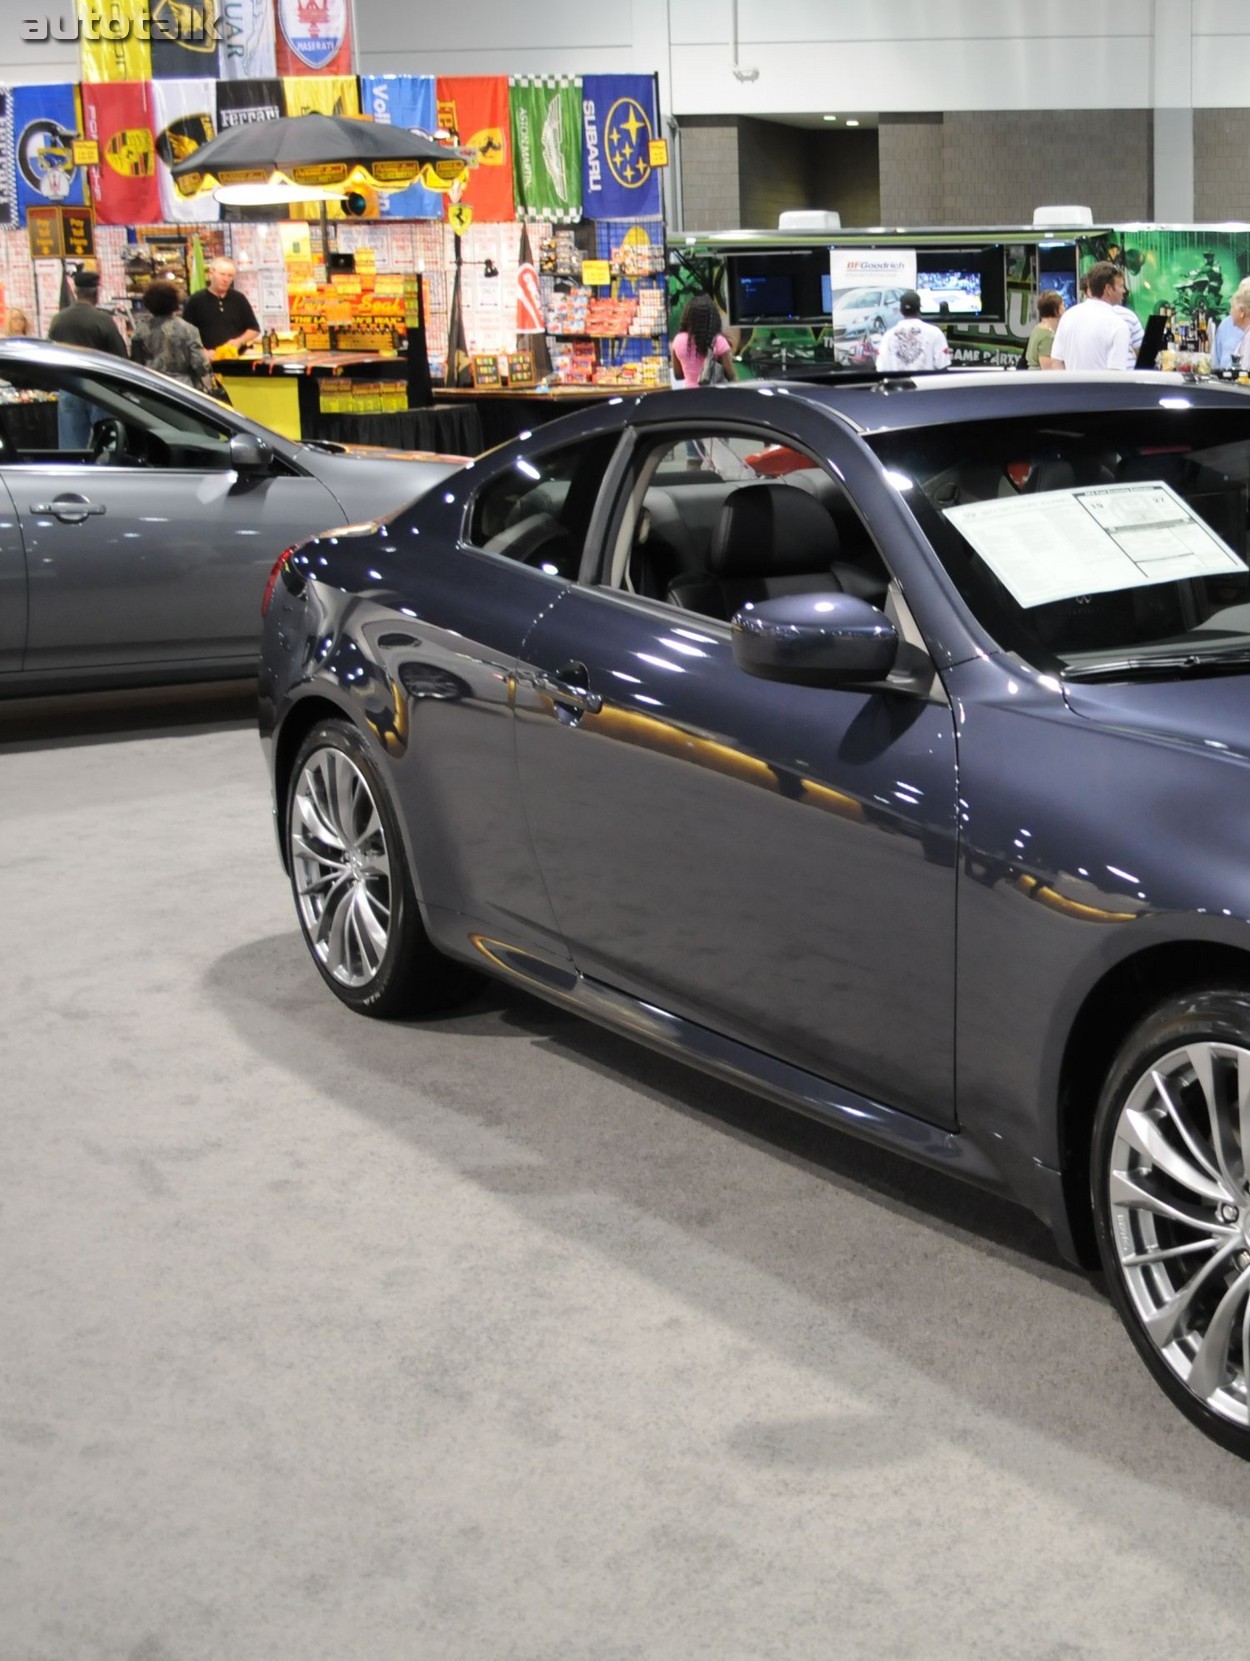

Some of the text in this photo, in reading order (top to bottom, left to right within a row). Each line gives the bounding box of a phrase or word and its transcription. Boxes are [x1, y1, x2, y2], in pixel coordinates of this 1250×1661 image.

[220, 105, 280, 128] Ferrari
[518, 107, 533, 188] ASTON MARTIN
[583, 100, 602, 192] SUBARU
